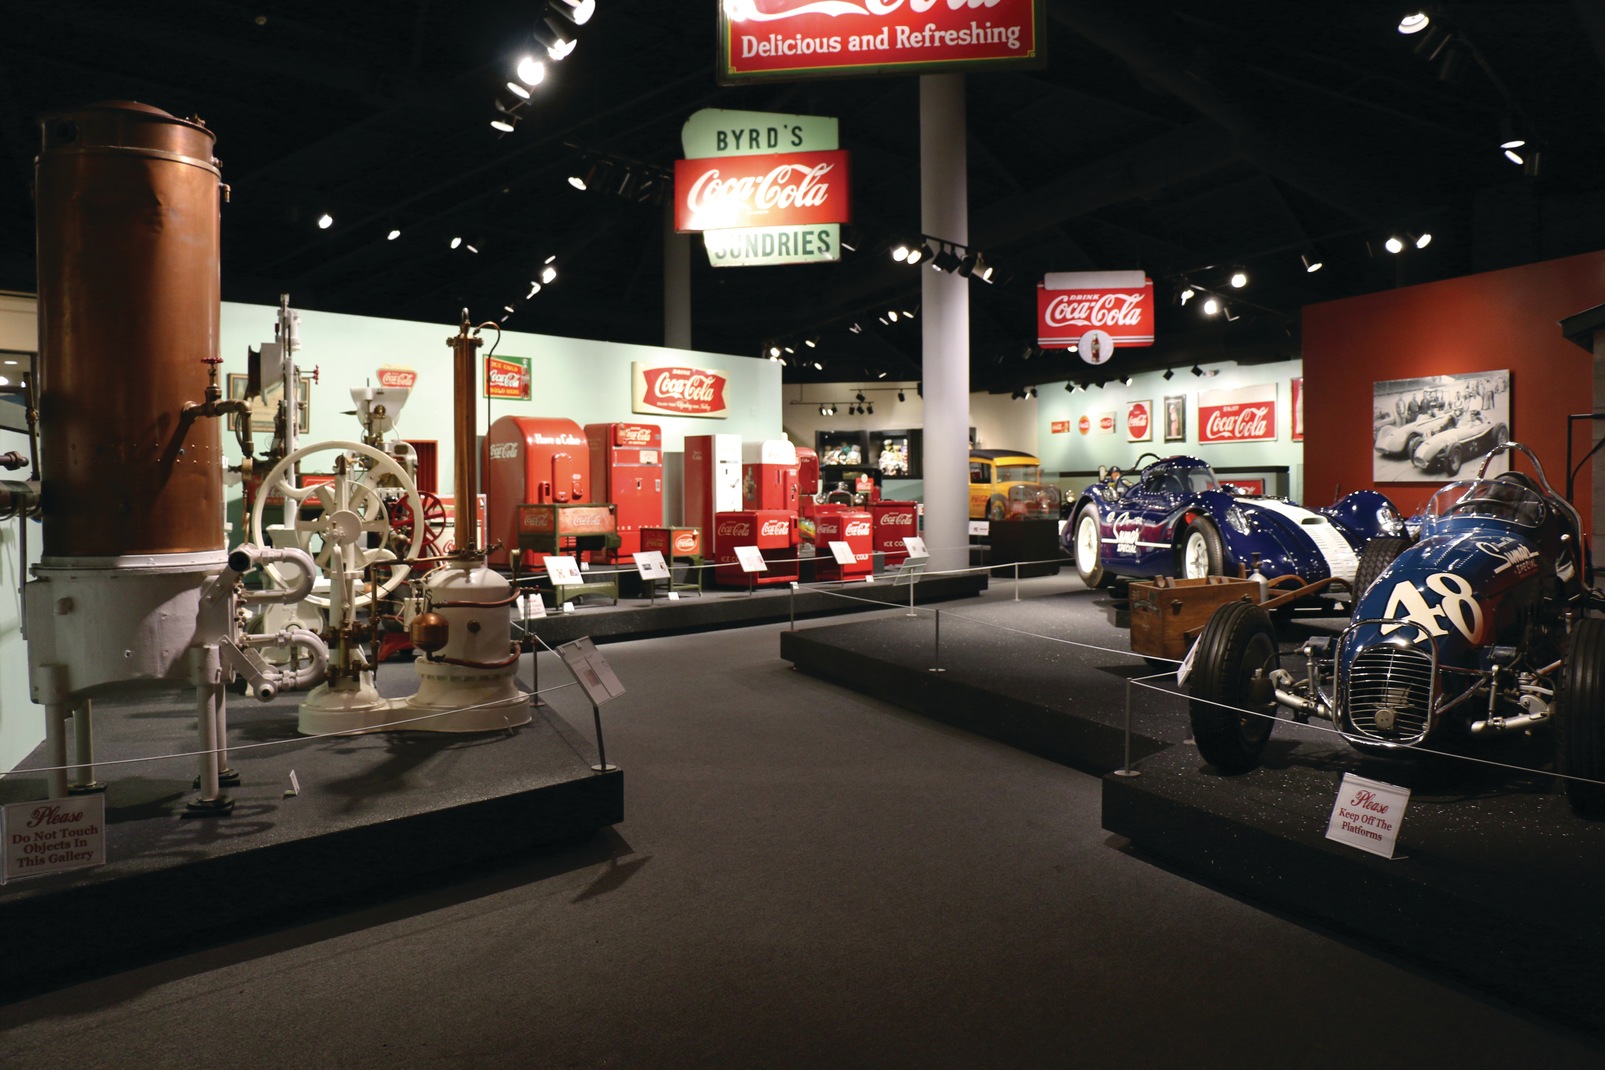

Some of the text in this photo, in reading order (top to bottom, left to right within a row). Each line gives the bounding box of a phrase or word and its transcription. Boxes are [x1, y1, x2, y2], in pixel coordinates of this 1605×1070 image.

[741, 22, 1021, 58] Delicious and Refreshing
[716, 125, 803, 151] BYRD'S
[687, 162, 835, 211] Coca-Cola
[714, 230, 831, 260] SUNDRIES
[1069, 293, 1101, 301] DRINK
[1045, 293, 1146, 327] Coca-Cola
[382, 372, 413, 387] Coca-Cola
[654, 371, 717, 402] Coca-Cola
[1206, 406, 1270, 439] Coca-Cola
[534, 433, 554, 445] Have
[561, 434, 581, 446] Coke
[718, 522, 750, 537] Coca-Cola
[762, 521, 790, 536] Coca-Cola
[845, 521, 871, 537] Coca-Cola
[881, 513, 913, 526] Coca-Cola
[1380, 572, 1484, 645] 48
[1351, 790, 1388, 814] Please
[26, 805, 84, 829] Please
[1339, 808, 1392, 831] Keep Off The
[12, 824, 99, 845] Do Not Touch
[1341, 821, 1382, 841] Platforms
[23, 838, 88, 855] Objects In
[17, 850, 95, 868] This Gallery
